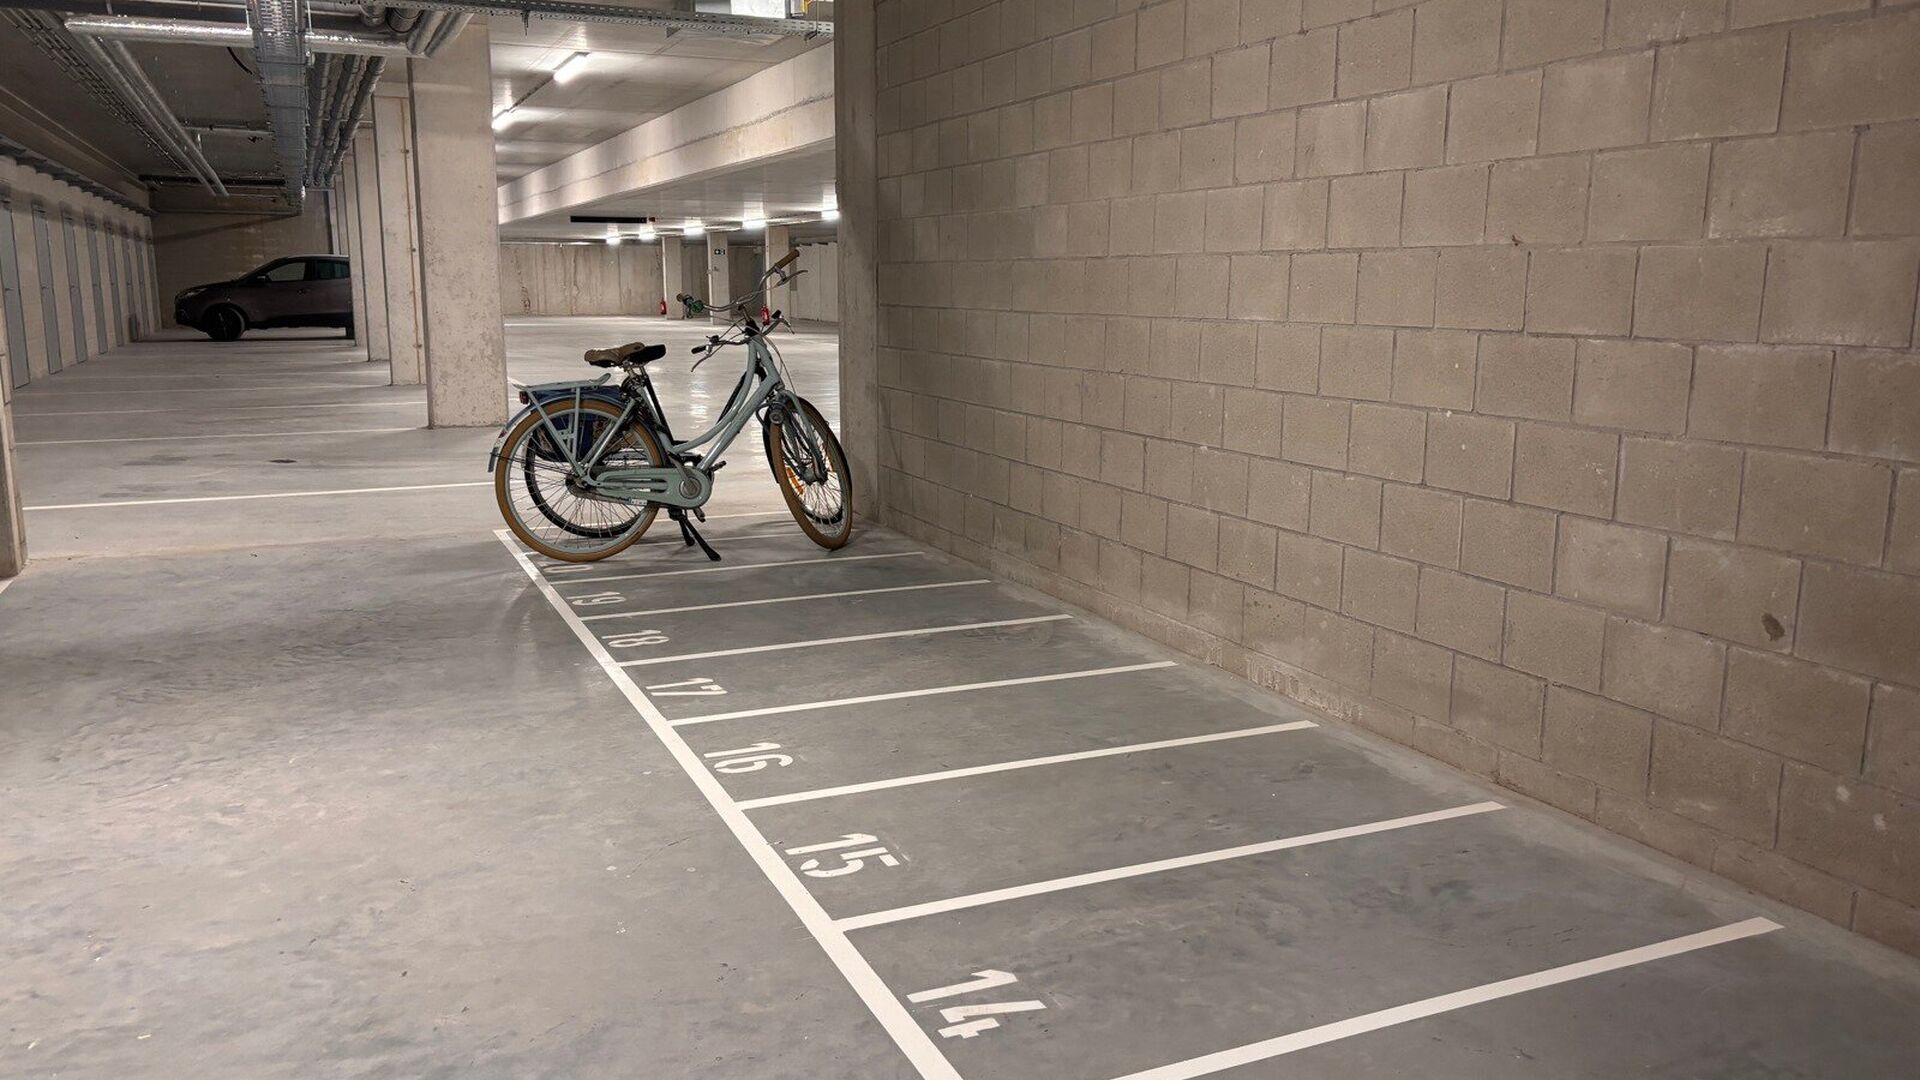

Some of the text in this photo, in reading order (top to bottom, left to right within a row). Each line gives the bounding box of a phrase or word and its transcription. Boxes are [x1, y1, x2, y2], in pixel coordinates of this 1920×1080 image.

[566, 591, 627, 606] 19
[602, 629, 670, 648] 18
[645, 677, 728, 697] 17
[703, 742, 794, 774] 16
[785, 833, 900, 878] 15
[906, 969, 1048, 1039] 14
